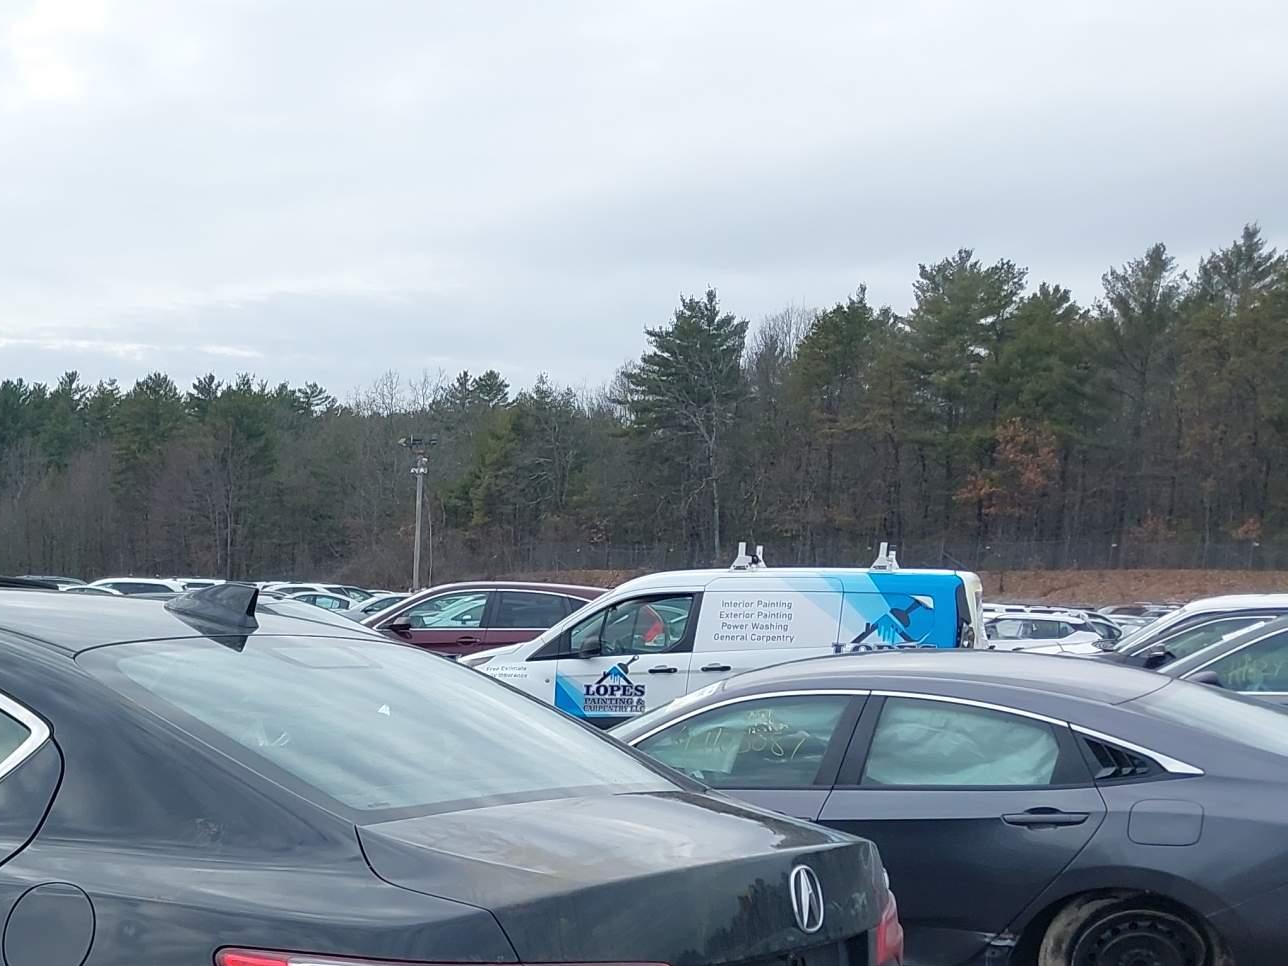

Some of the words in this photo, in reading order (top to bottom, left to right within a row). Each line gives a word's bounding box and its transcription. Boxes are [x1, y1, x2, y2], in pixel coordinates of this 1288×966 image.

[721, 600, 754, 608] Interior
[756, 600, 792, 609] Painting
[719, 611, 754, 619] Exterior
[757, 611, 793, 620] Painting
[721, 622, 748, 630] Power
[751, 622, 789, 631] Washing
[713, 633, 748, 641] General
[750, 633, 794, 642] Carpentry
[583, 684, 646, 697] LOPES
[584, 697, 634, 705] PAINTING
